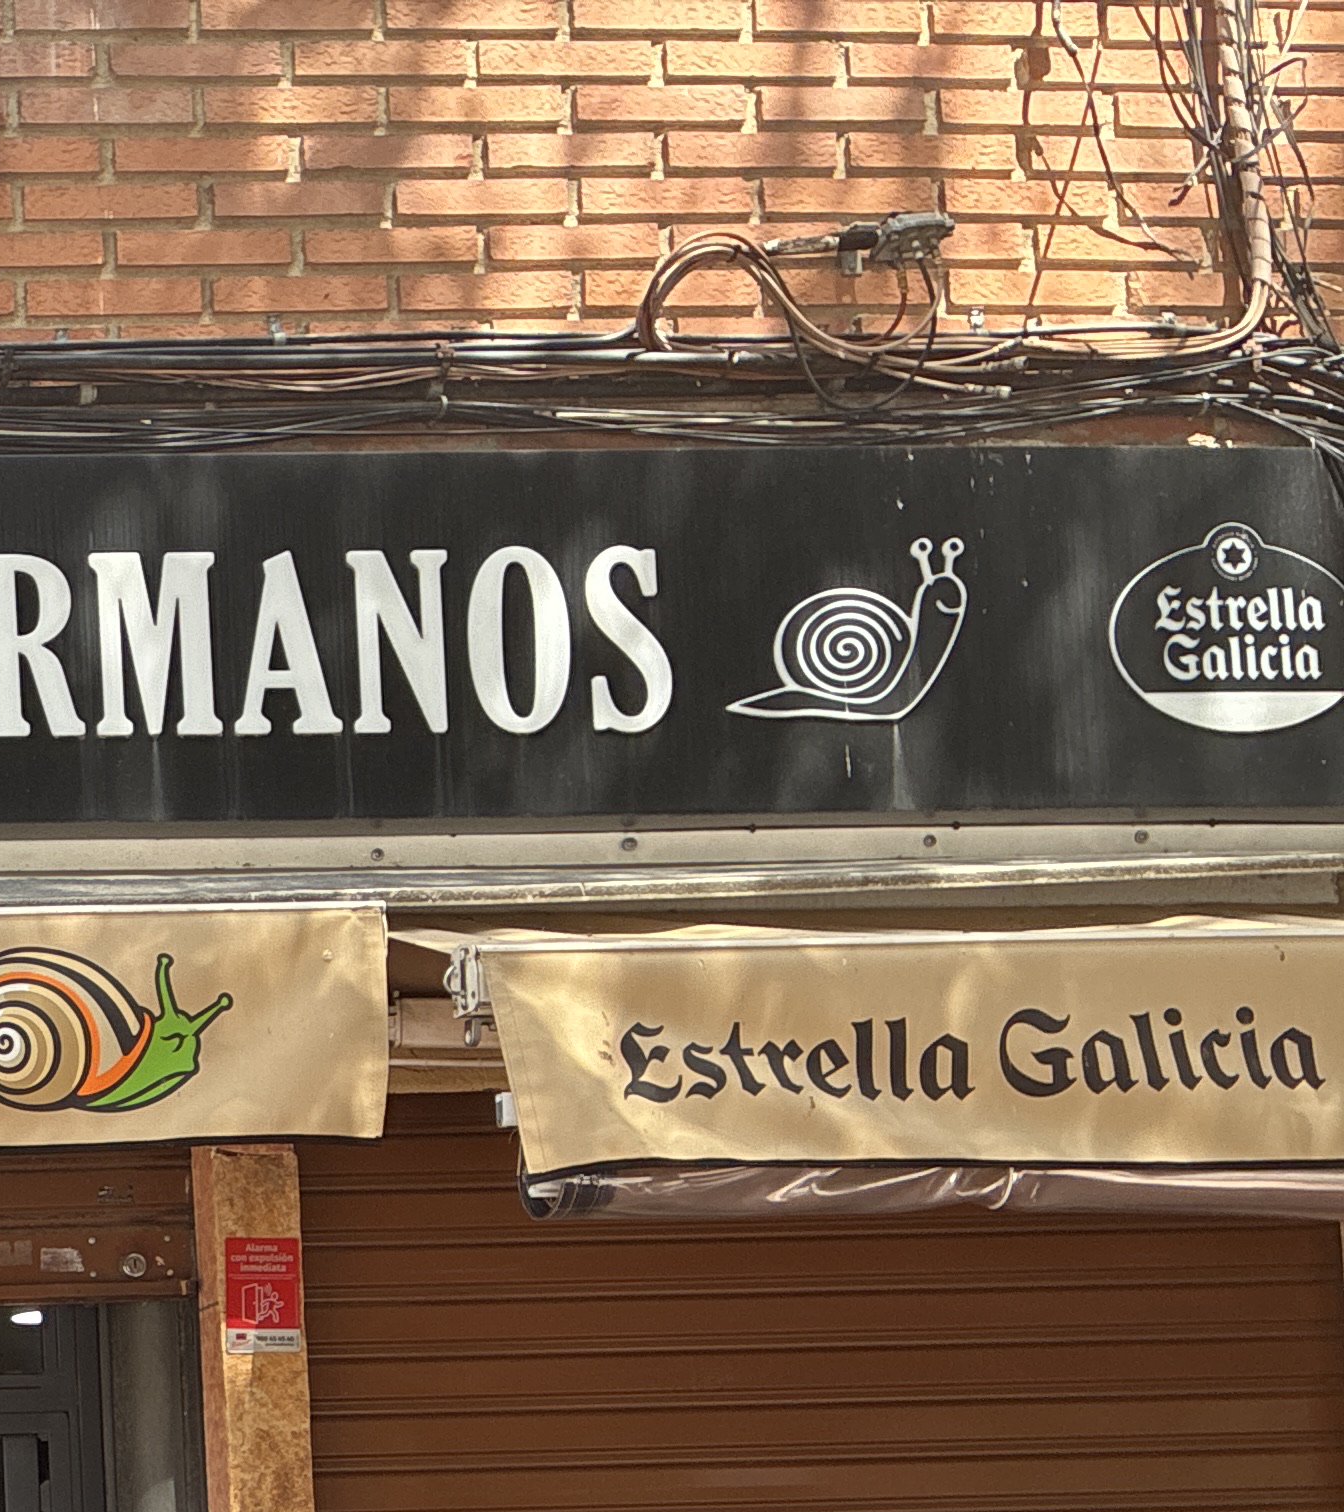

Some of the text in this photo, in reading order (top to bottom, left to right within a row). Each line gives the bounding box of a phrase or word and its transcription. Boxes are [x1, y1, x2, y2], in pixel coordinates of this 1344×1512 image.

[1154, 584, 1327, 632] Estrella
[1163, 632, 1324, 682] Galicia
[618, 1005, 1327, 1104] Estrella Galicia
[230, 1252, 295, 1264] con expulsión
[245, 1242, 279, 1253] Alarma
[239, 1262, 288, 1273] inmediata
